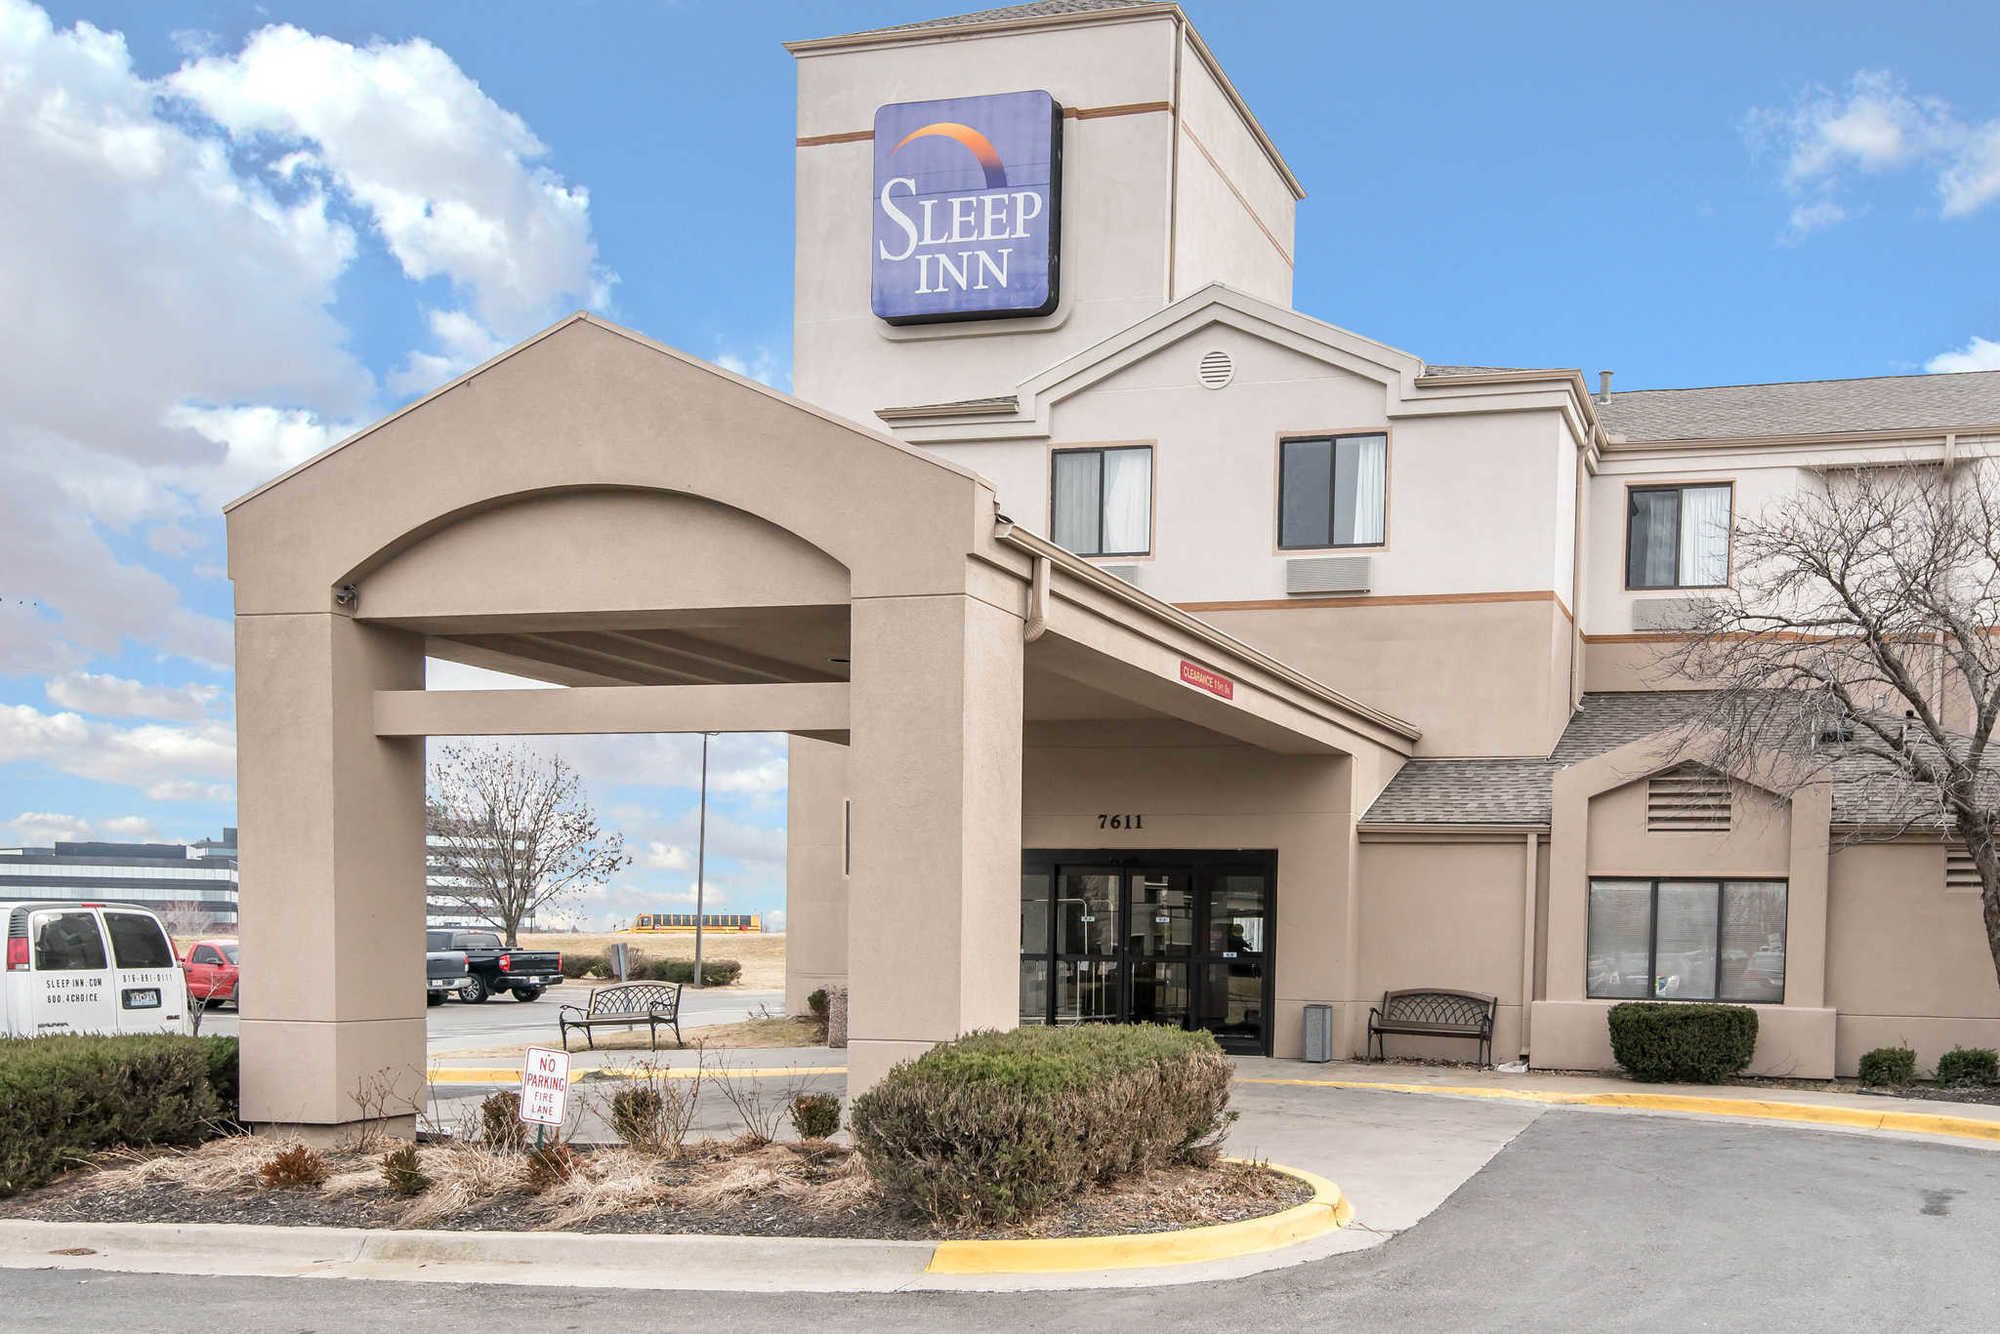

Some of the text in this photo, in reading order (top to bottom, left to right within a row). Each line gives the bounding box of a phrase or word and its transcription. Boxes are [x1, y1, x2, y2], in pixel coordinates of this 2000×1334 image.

[880, 177, 1042, 261] SLEEP
[915, 248, 1013, 293] INN
[1097, 814, 1143, 829] 7611
[540, 1057, 556, 1073] NO
[526, 1073, 565, 1092] PARKING
[534, 1091, 553, 1103] FIRE
[531, 1104, 553, 1116] LANE
